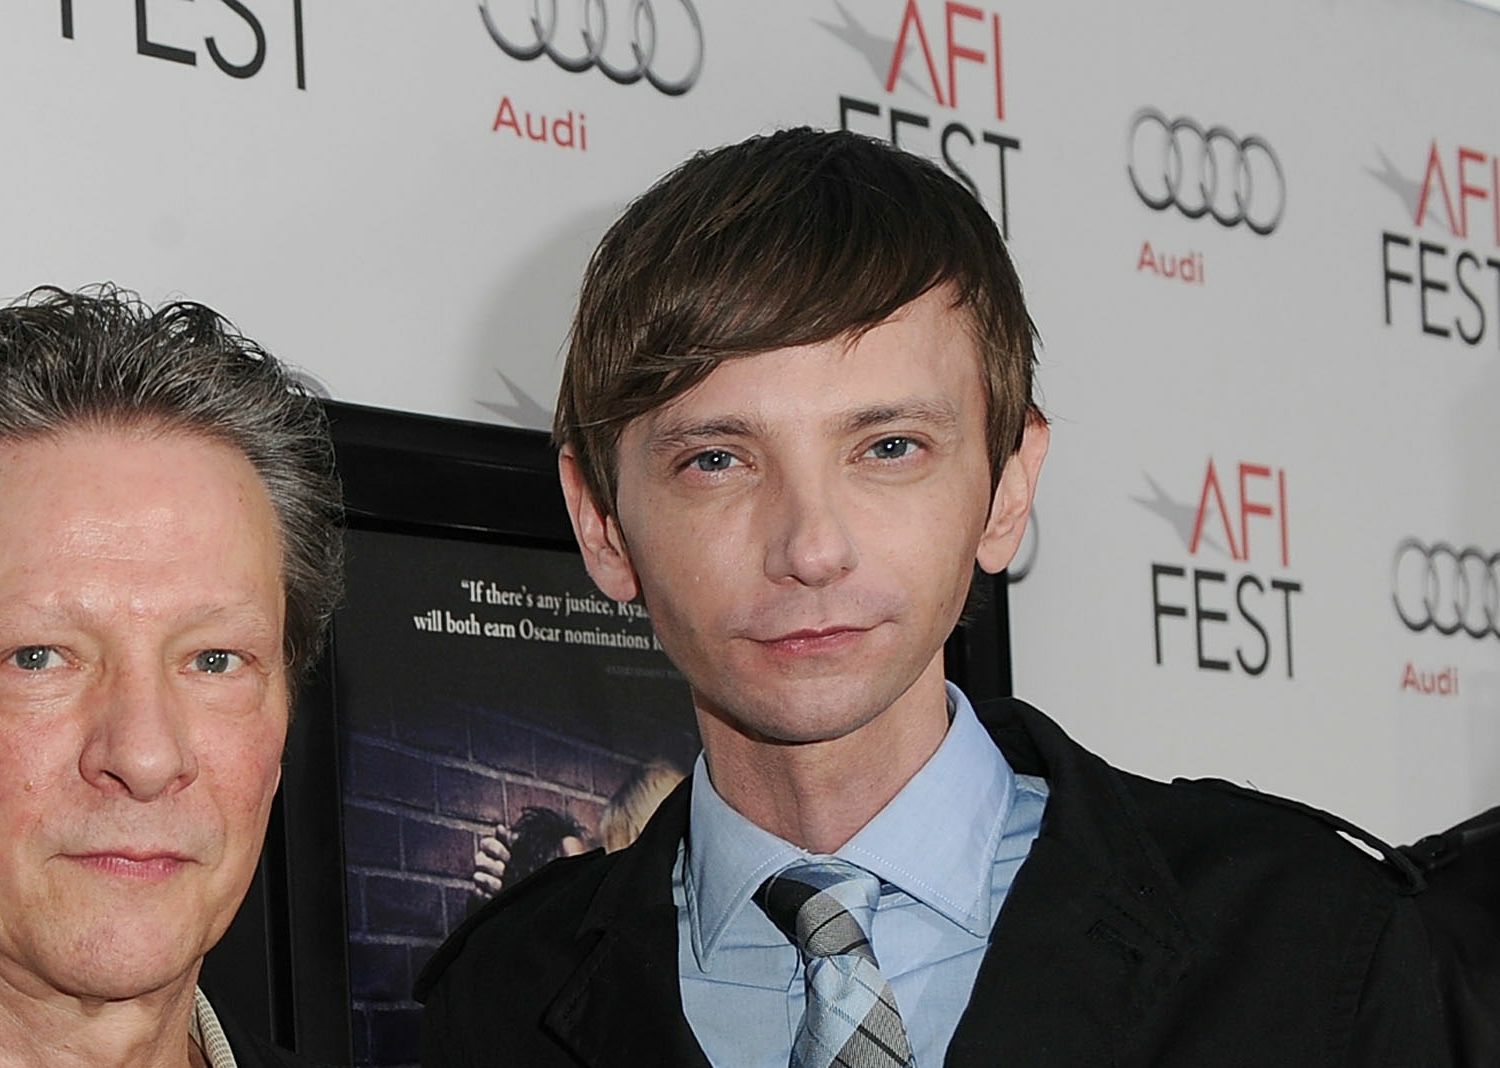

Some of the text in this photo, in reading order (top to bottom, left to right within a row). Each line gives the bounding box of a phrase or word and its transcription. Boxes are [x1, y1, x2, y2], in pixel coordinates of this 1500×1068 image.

[884, 0, 1006, 122] AFI
[491, 95, 588, 151] Audi
[1414, 139, 1500, 248] AFI
[1135, 240, 1206, 286] Audi
[1187, 457, 1290, 567] AFI
[460, 579, 485, 603] “If
[485, 582, 534, 608] there’s
[536, 594, 562, 616] any
[564, 591, 615, 618] justice,
[1151, 562, 1303, 680] FEST
[413, 609, 442, 632] will
[445, 611, 481, 636] both
[484, 621, 516, 639] earn
[519, 618, 562, 642] Oscar
[564, 627, 651, 650] nominations
[1401, 662, 1459, 697] Audi
